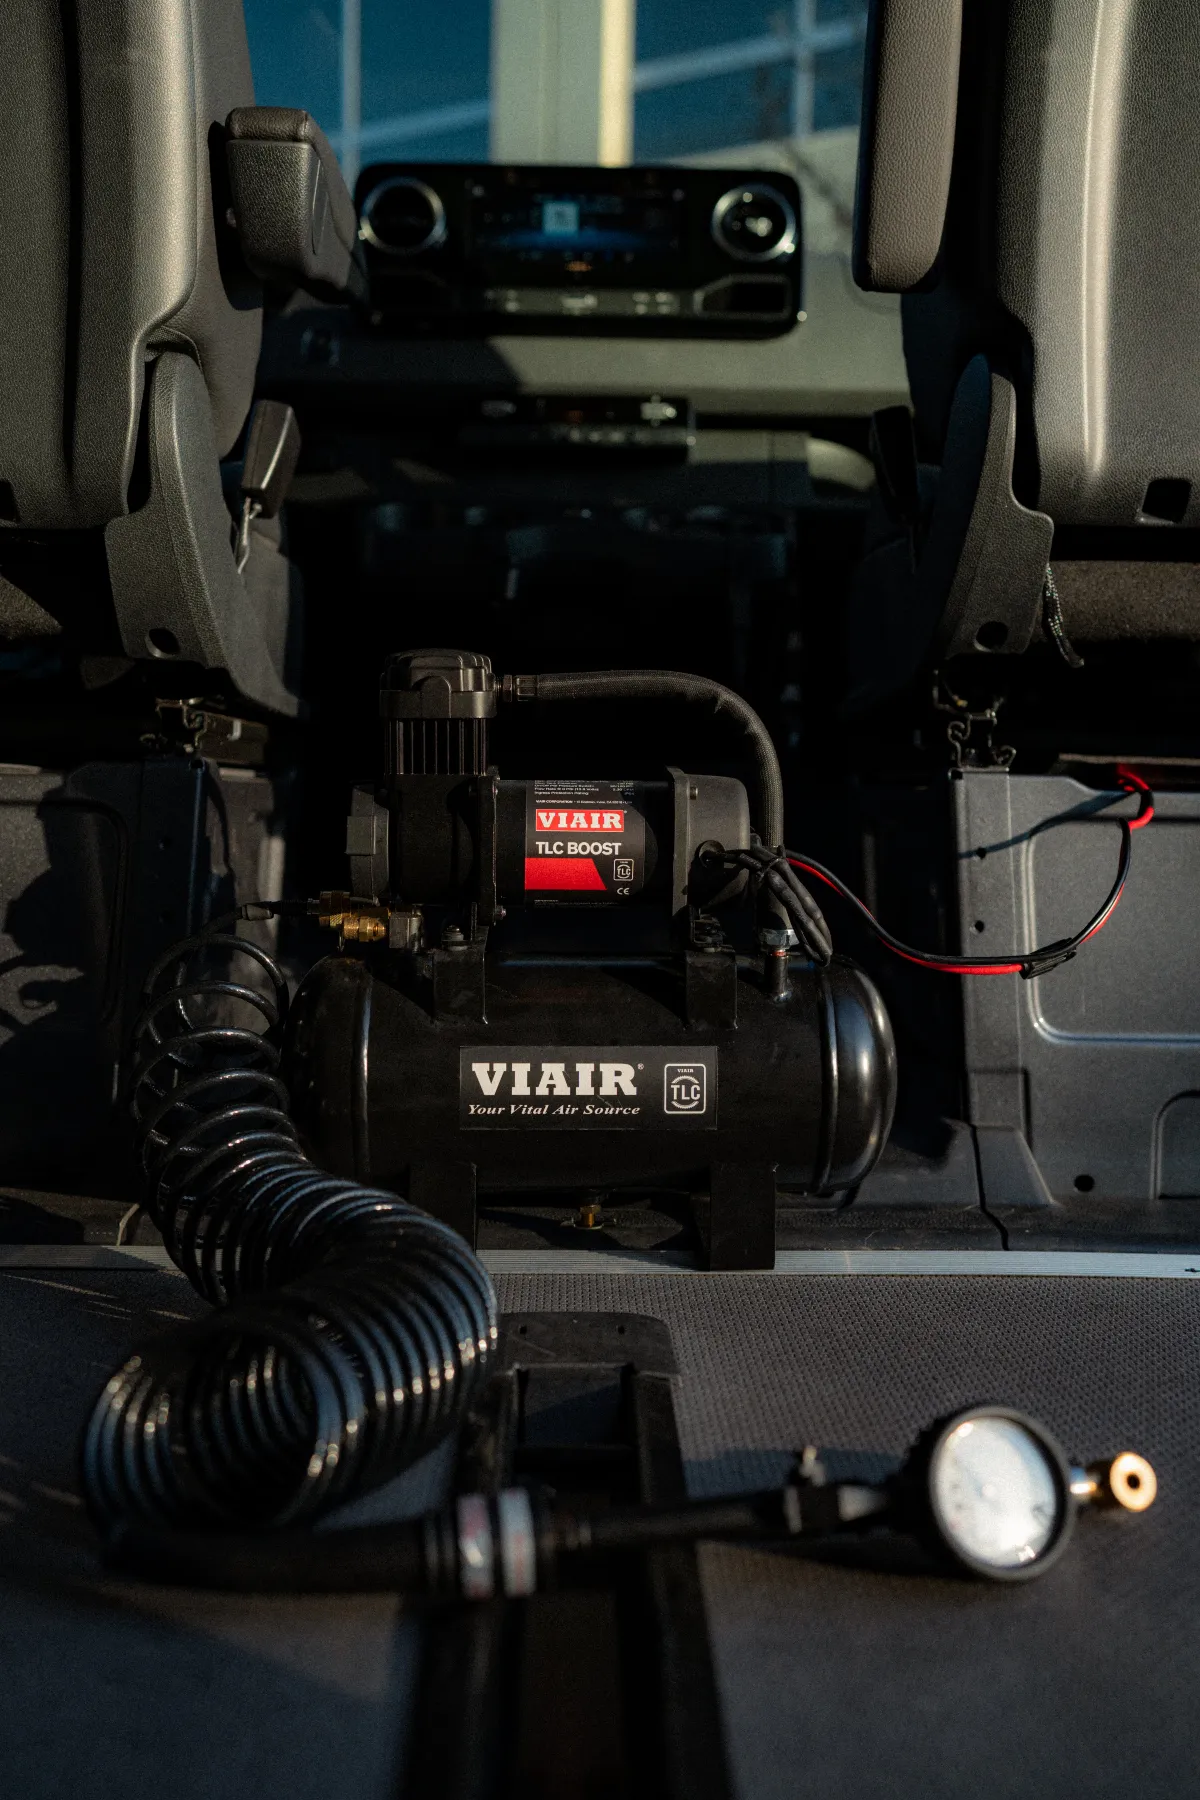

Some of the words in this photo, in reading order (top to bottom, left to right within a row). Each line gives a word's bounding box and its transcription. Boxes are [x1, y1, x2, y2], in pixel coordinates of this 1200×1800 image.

[537, 812, 622, 829] VIAIR
[535, 841, 564, 855] TLC
[567, 842, 622, 856] BOOST
[616, 867, 631, 876] TLC
[616, 887, 630, 895] CE
[670, 1084, 701, 1100] TLC
[468, 1104, 506, 1115] Your
[509, 1104, 549, 1115] Vital
[552, 1104, 579, 1115] Air
[583, 1104, 640, 1115] Source
